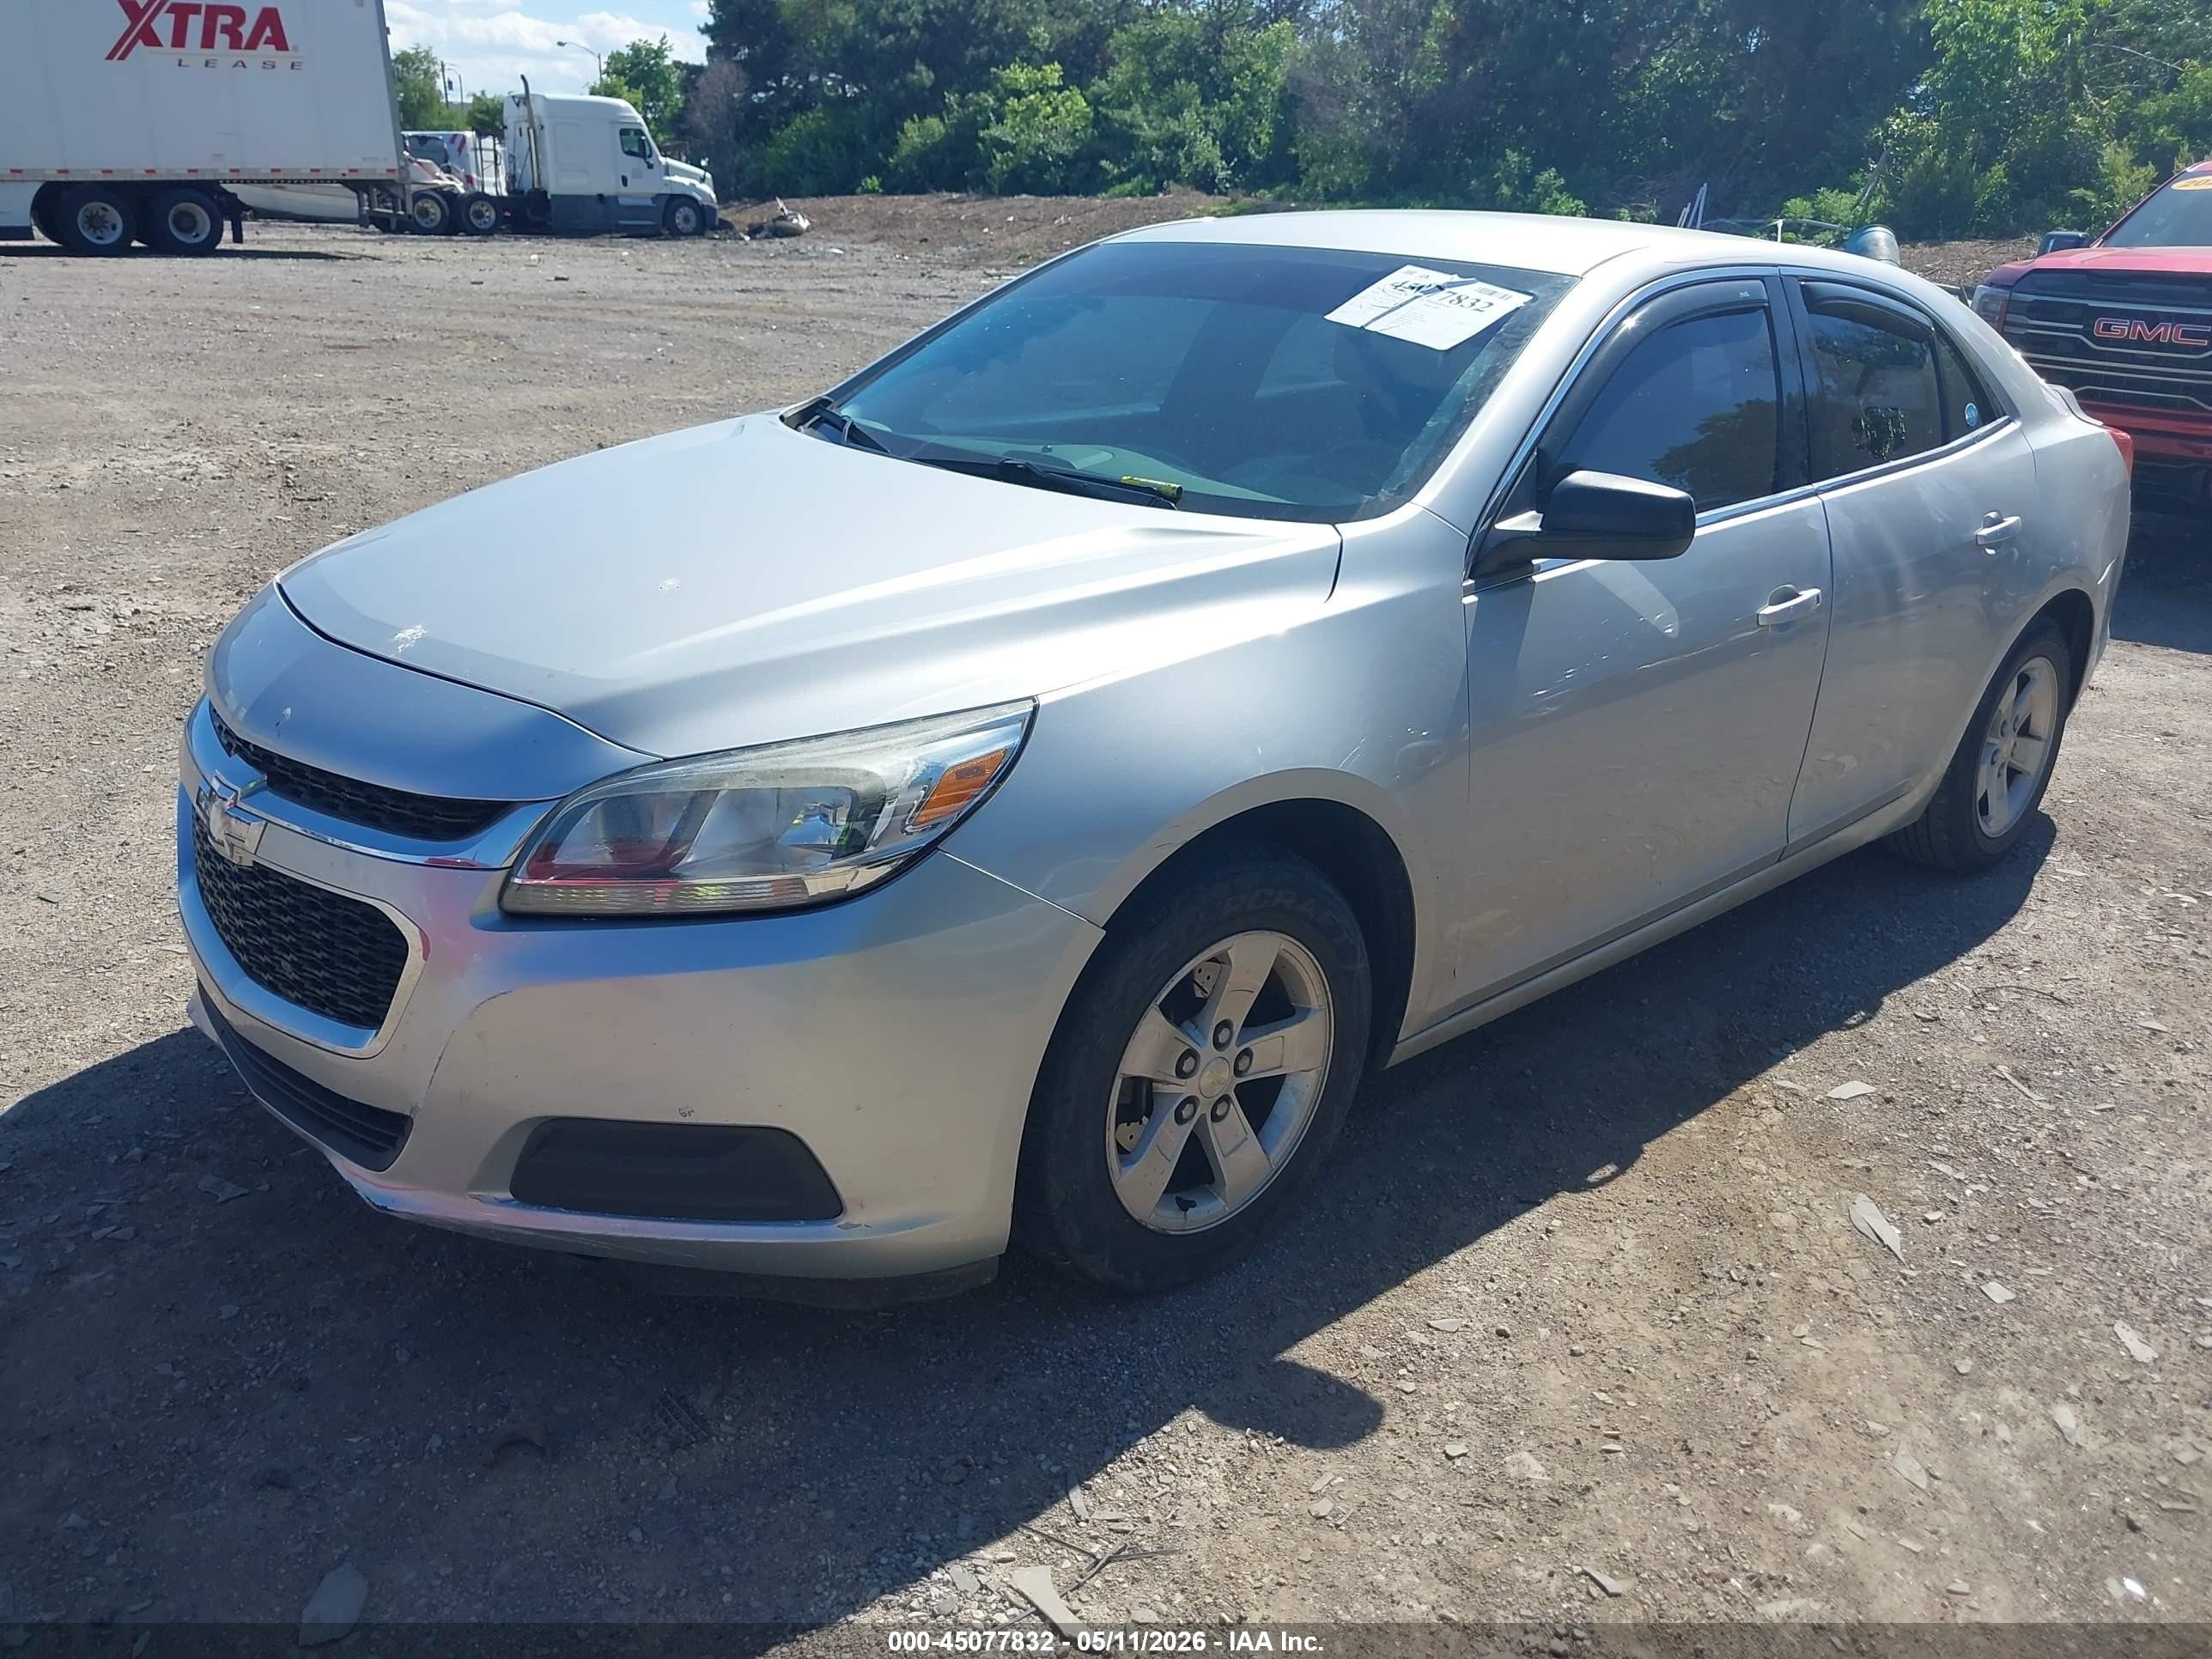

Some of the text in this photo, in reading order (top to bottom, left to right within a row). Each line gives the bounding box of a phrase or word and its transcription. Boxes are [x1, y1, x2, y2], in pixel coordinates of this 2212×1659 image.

[105, 0, 289, 61] XTRA
[177, 58, 303, 70] LEASE
[2094, 317, 2212, 346] GMC
